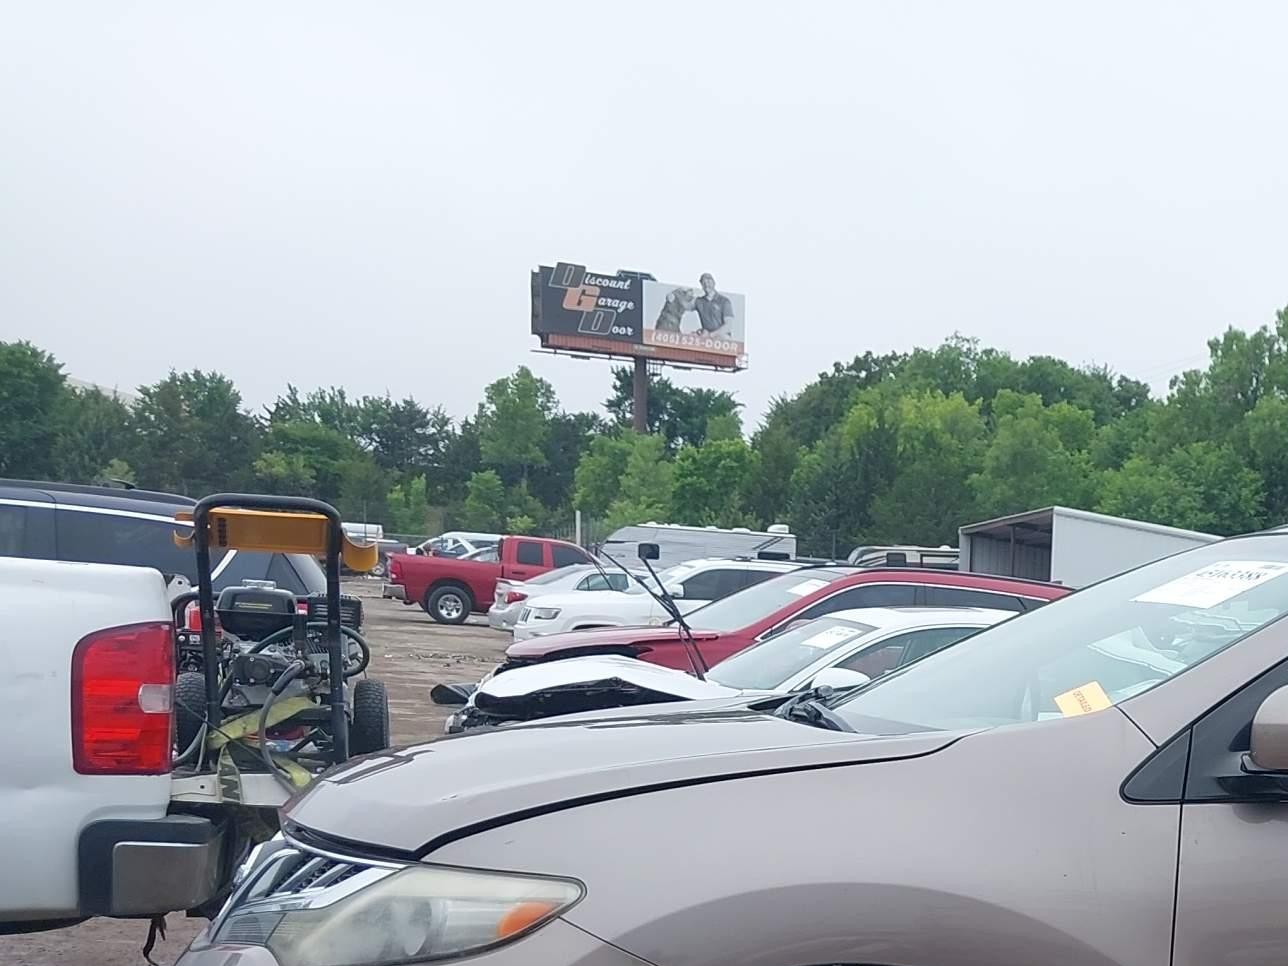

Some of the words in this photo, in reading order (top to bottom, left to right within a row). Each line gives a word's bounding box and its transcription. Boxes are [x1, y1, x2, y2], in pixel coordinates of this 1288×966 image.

[549, 262, 631, 289] Discount
[562, 285, 635, 313] Garage
[578, 308, 634, 336] Door
[651, 332, 679, 345] (405)
